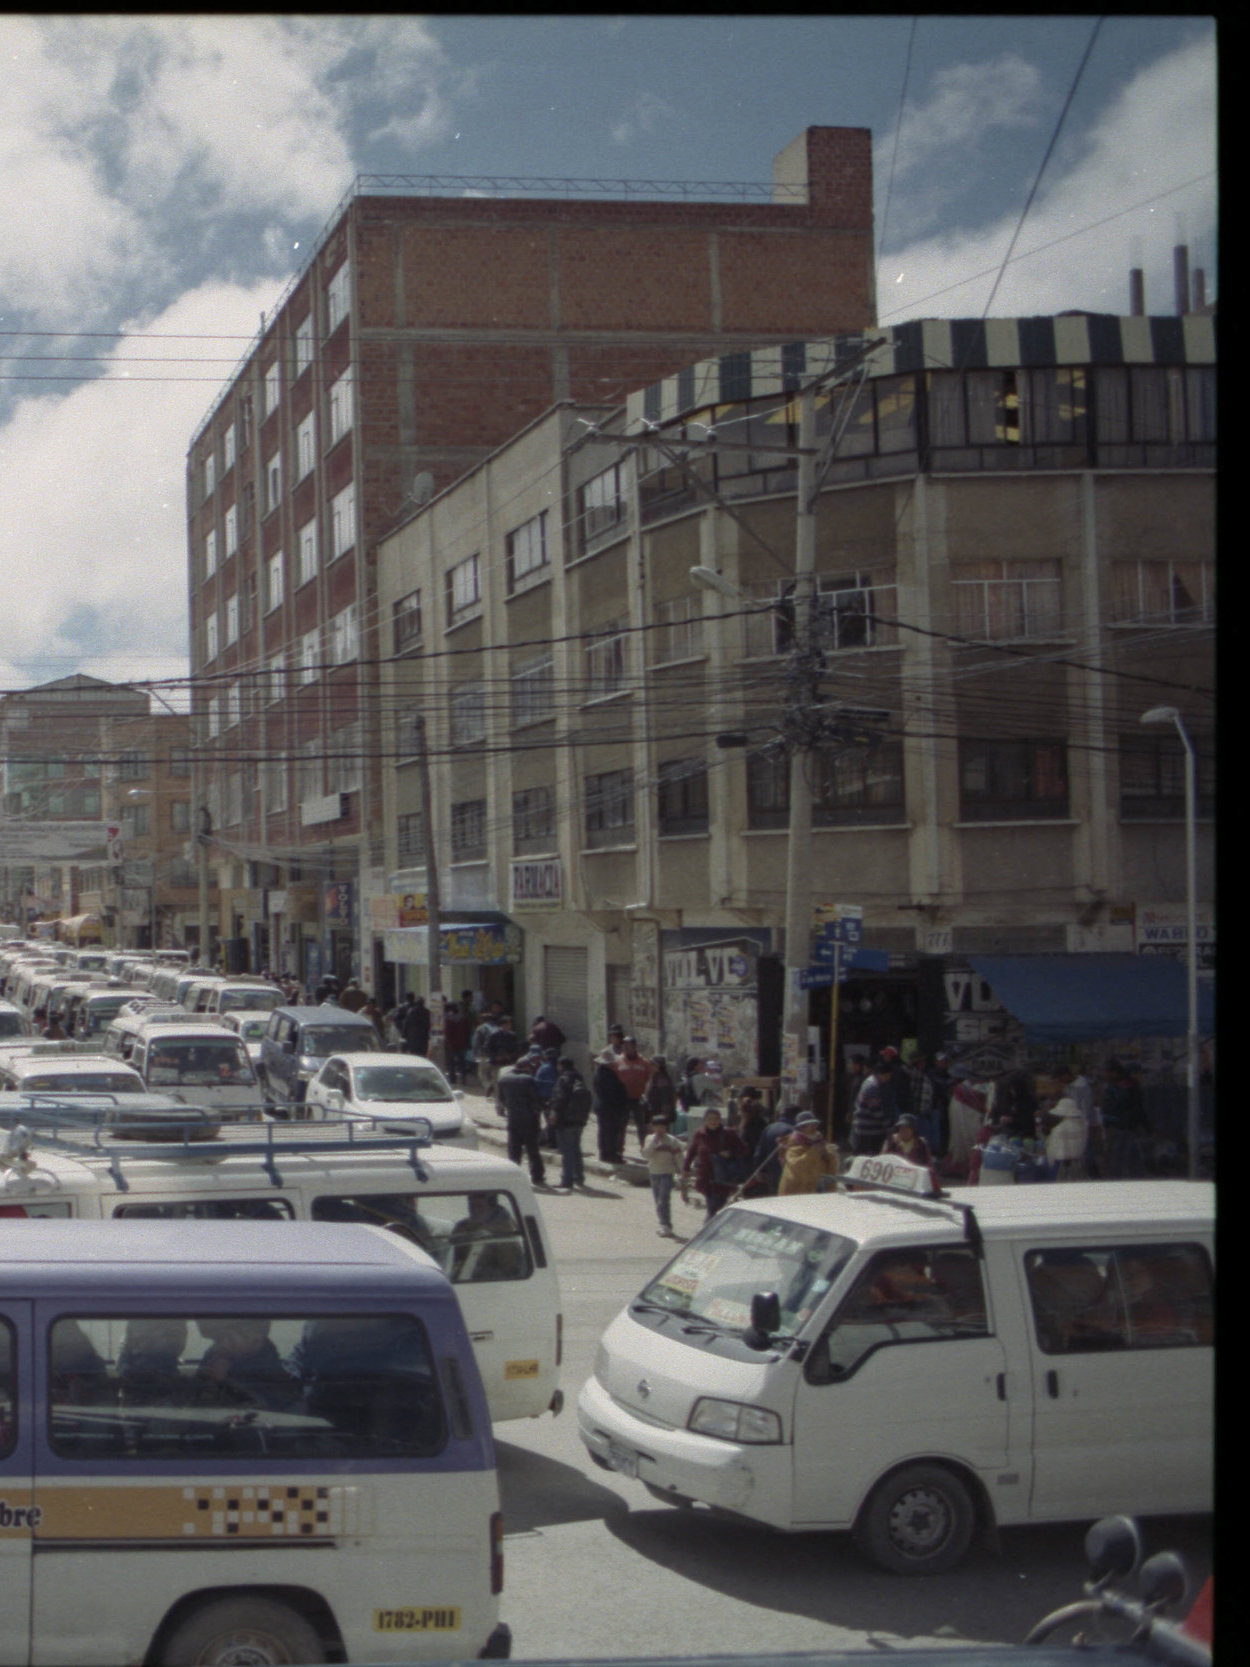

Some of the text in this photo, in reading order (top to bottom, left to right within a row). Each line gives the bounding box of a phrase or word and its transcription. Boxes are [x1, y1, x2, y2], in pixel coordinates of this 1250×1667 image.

[513, 865, 560, 898] FARMACIA
[860, 1160, 894, 1185] 690
[378, 1610, 455, 1629] 1782-PHI
